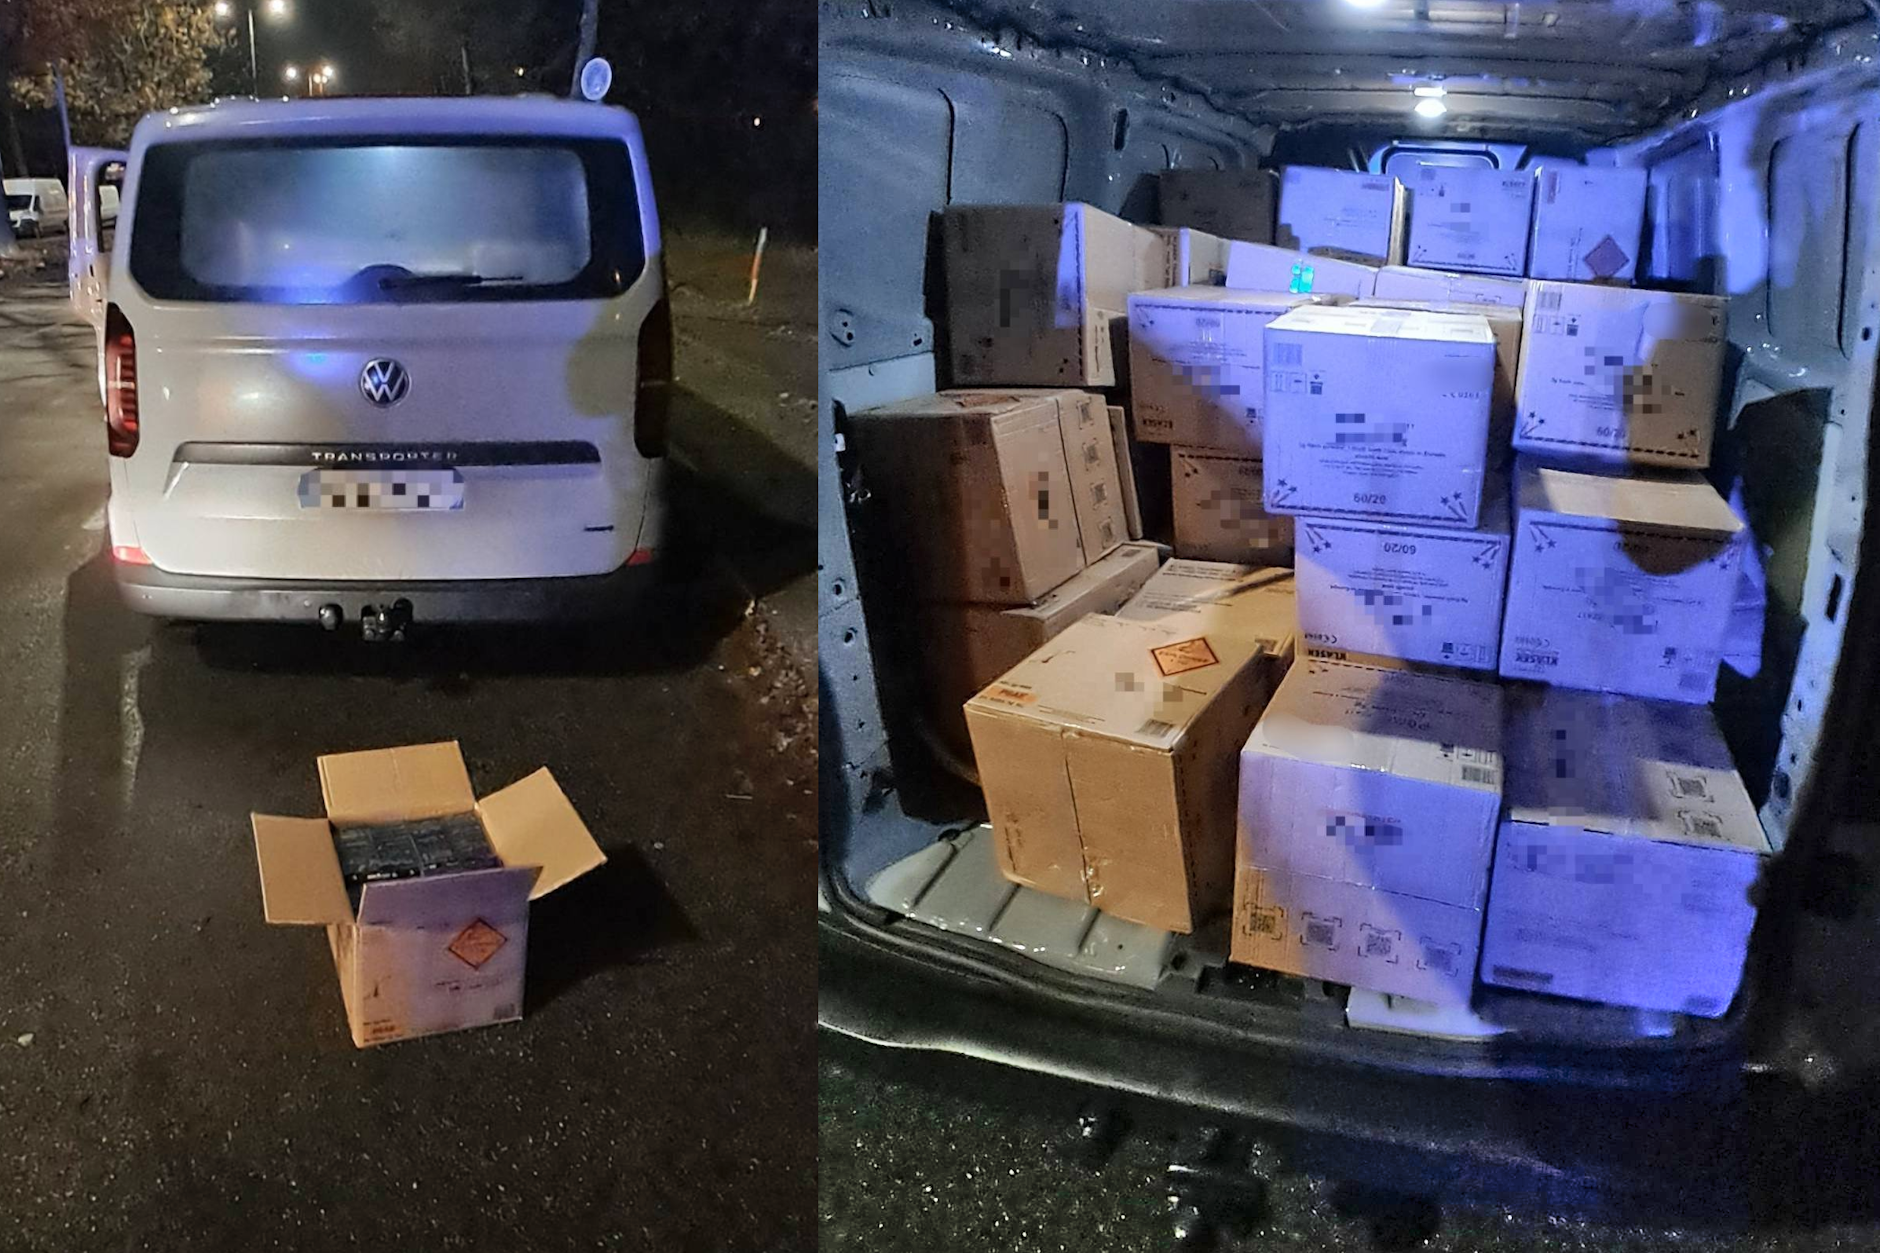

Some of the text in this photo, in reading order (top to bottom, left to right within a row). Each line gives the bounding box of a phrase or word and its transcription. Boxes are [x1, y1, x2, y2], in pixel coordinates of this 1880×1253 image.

[311, 451, 458, 462] TRANSPORTER
[1353, 493, 1387, 505] 60/20
[1383, 542, 1417, 555] 60/20
